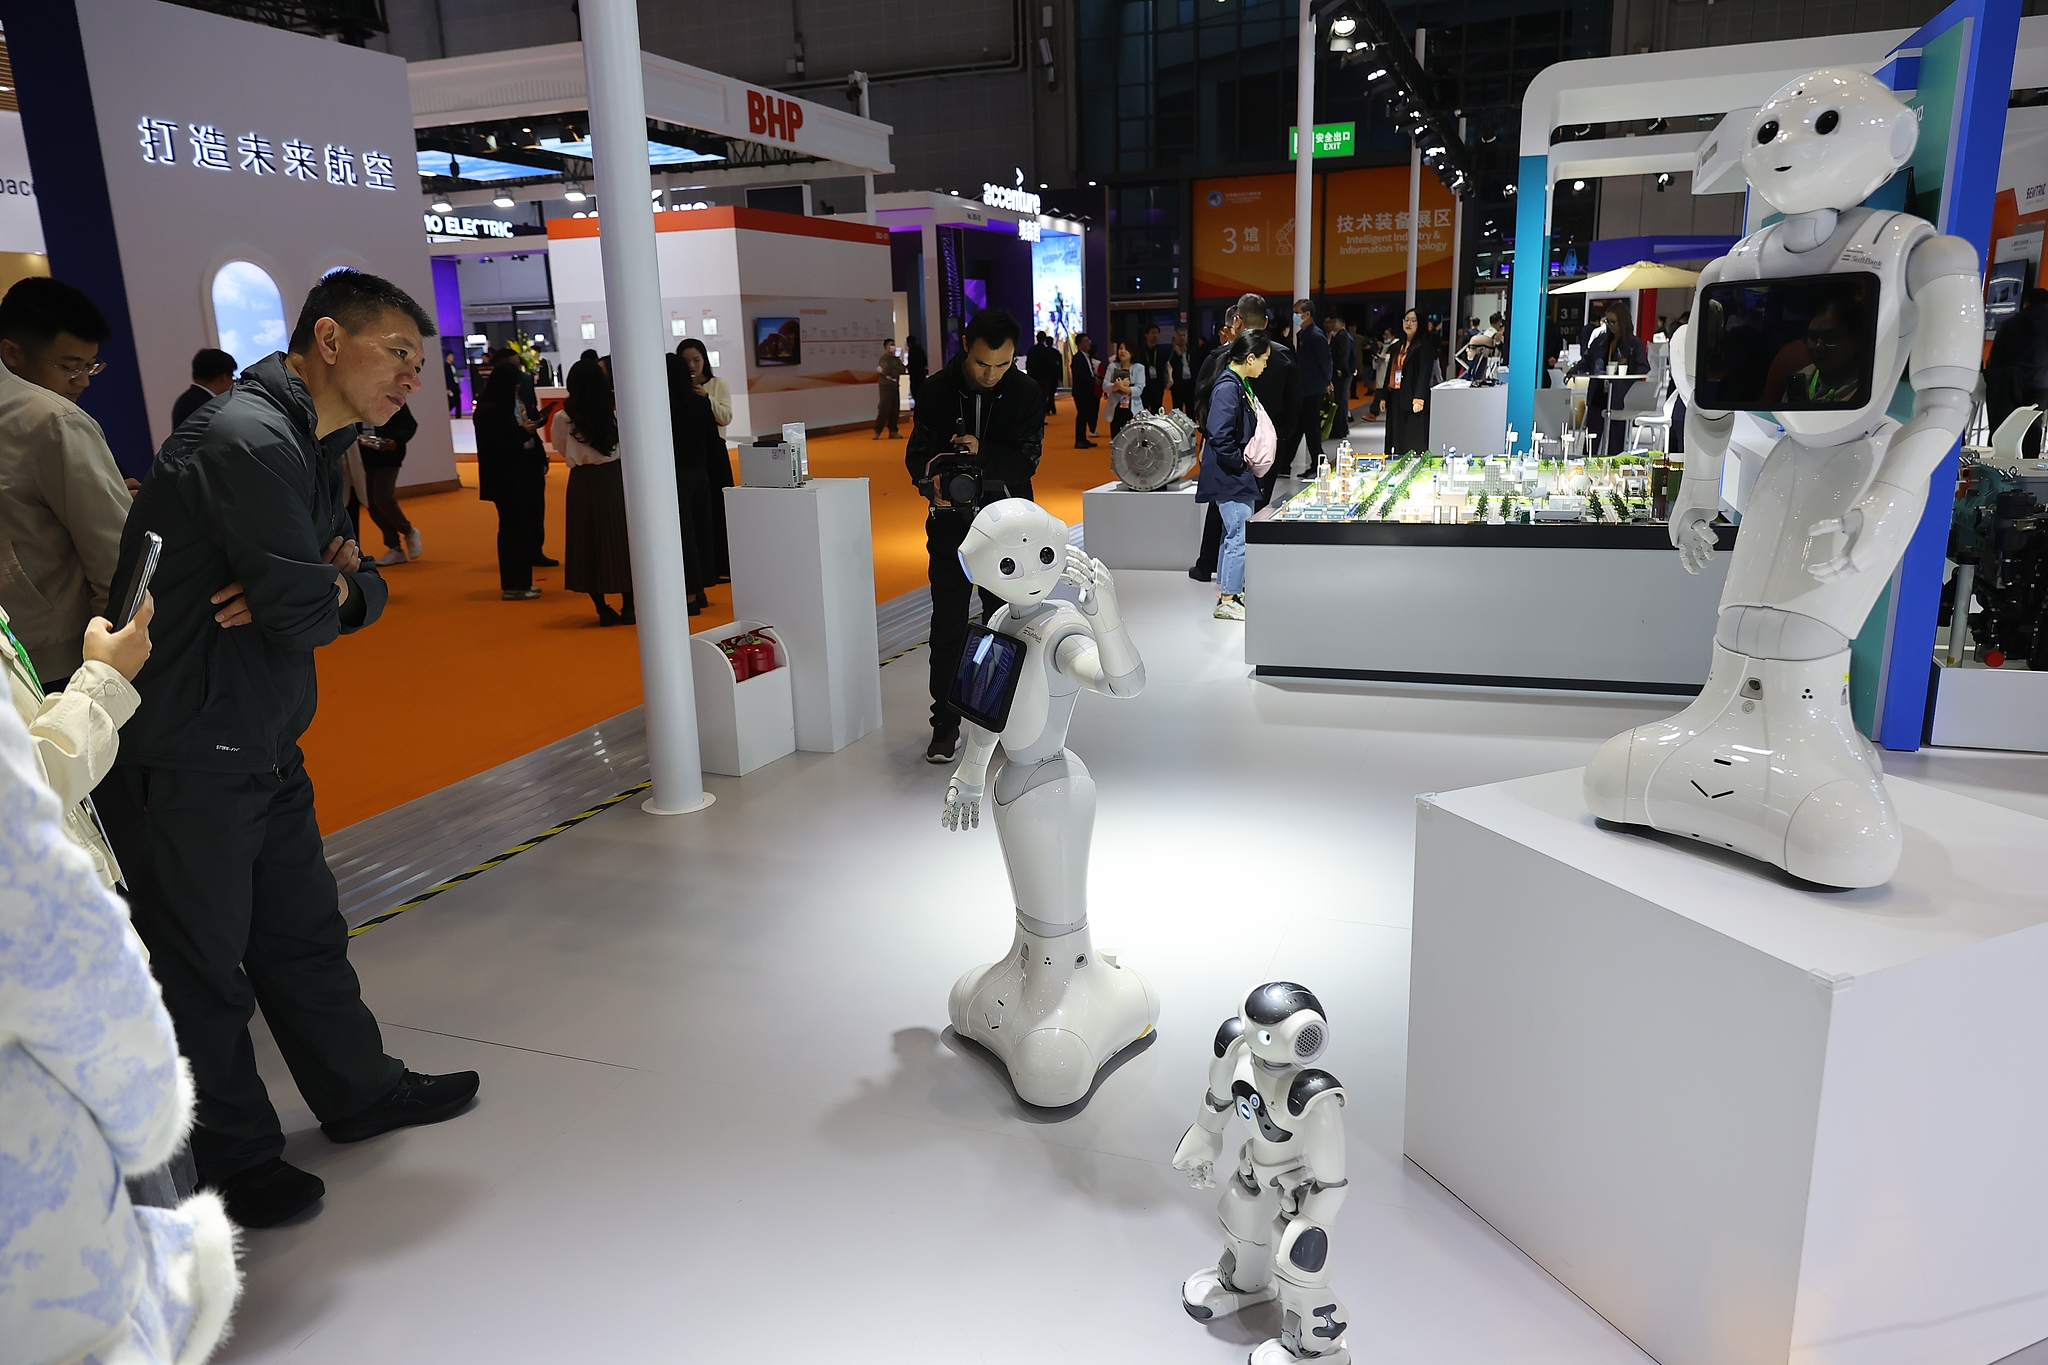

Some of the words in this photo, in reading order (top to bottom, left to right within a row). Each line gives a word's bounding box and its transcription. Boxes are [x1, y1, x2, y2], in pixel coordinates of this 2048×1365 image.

[746, 89, 804, 143] BHP
[1315, 131, 1351, 144] 安全出口
[1323, 141, 1341, 151] EXIT
[137, 115, 398, 191] 打造未来航空
[983, 182, 1041, 216] accenture
[444, 216, 514, 238] ELECTRIC
[1336, 209, 1452, 233] 技术装备展区
[1222, 227, 1238, 254] 3
[1243, 226, 1259, 242] 馆
[1346, 233, 1392, 245] Intelligent
[1394, 229, 1432, 242] Indtry
[1433, 230, 1441, 240] &
[1243, 243, 1260, 252] Hall
[1340, 243, 1393, 255] Information
[1851, 255, 1882, 267] SoftBank
